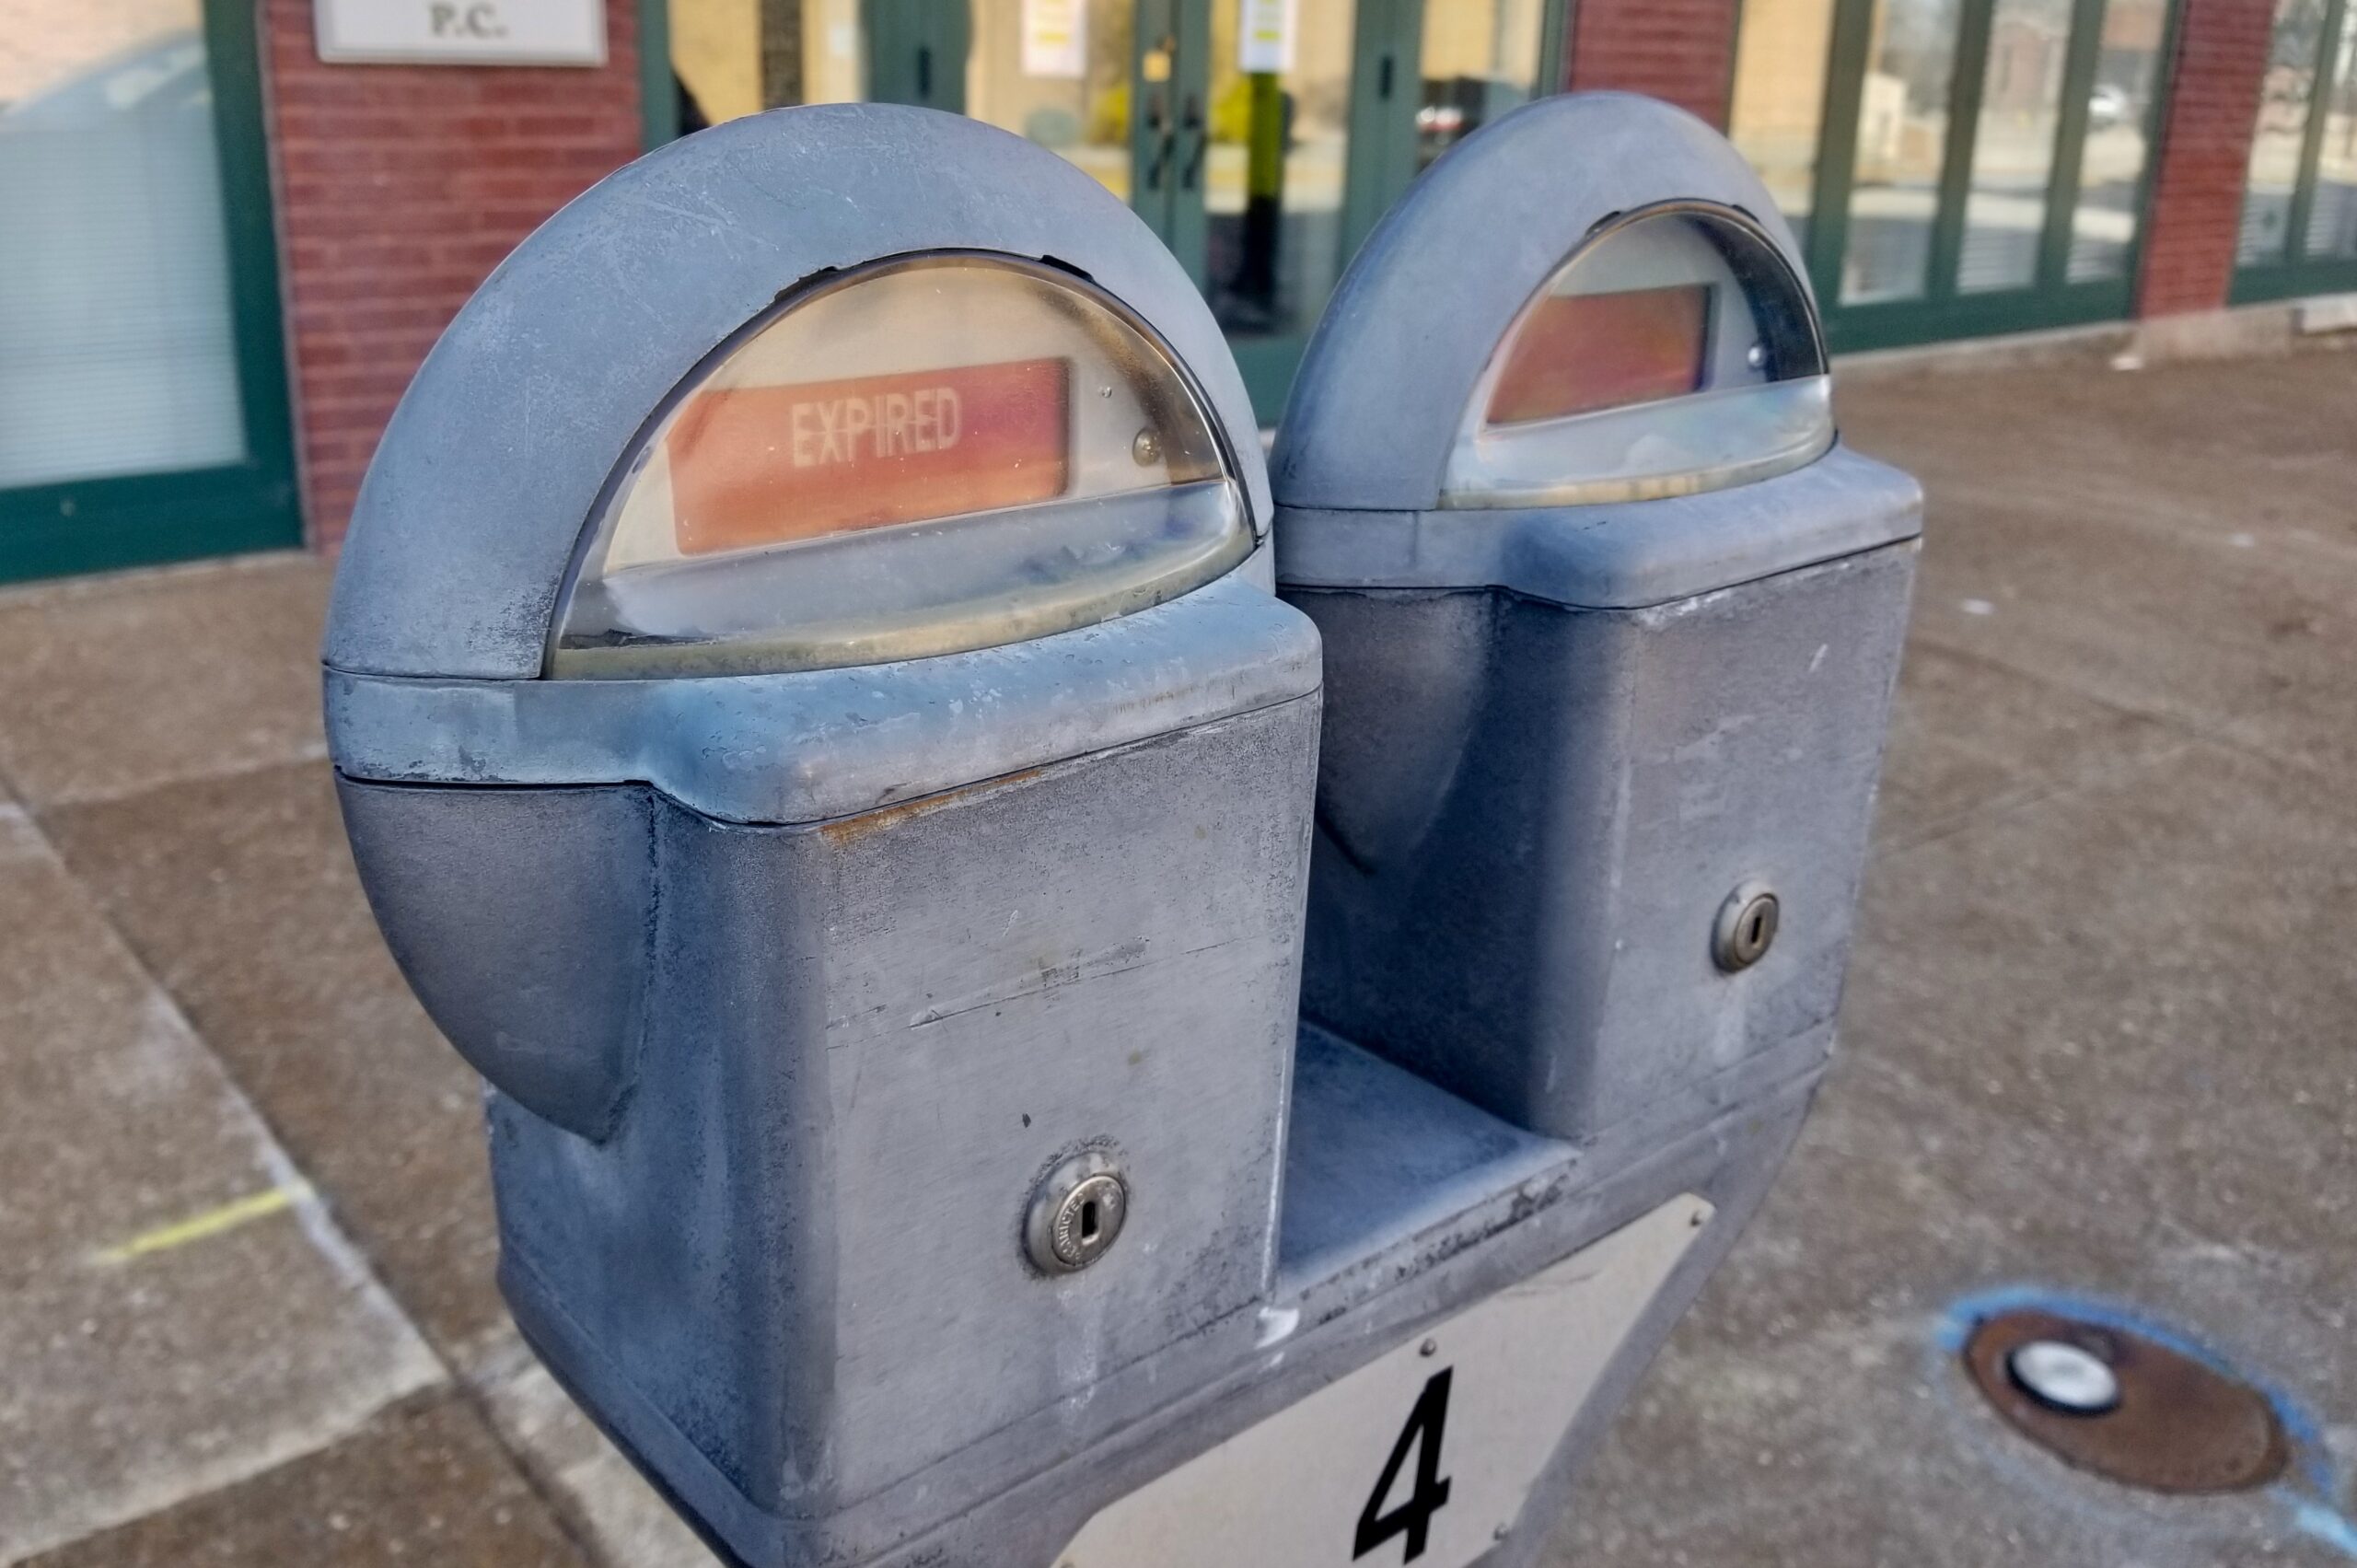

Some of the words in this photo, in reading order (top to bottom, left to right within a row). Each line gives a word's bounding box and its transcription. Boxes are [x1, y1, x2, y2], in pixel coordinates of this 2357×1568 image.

[430, 2, 509, 39] P.C.
[792, 387, 962, 468] EXPIRED
[1353, 1365, 1454, 1566] 4
